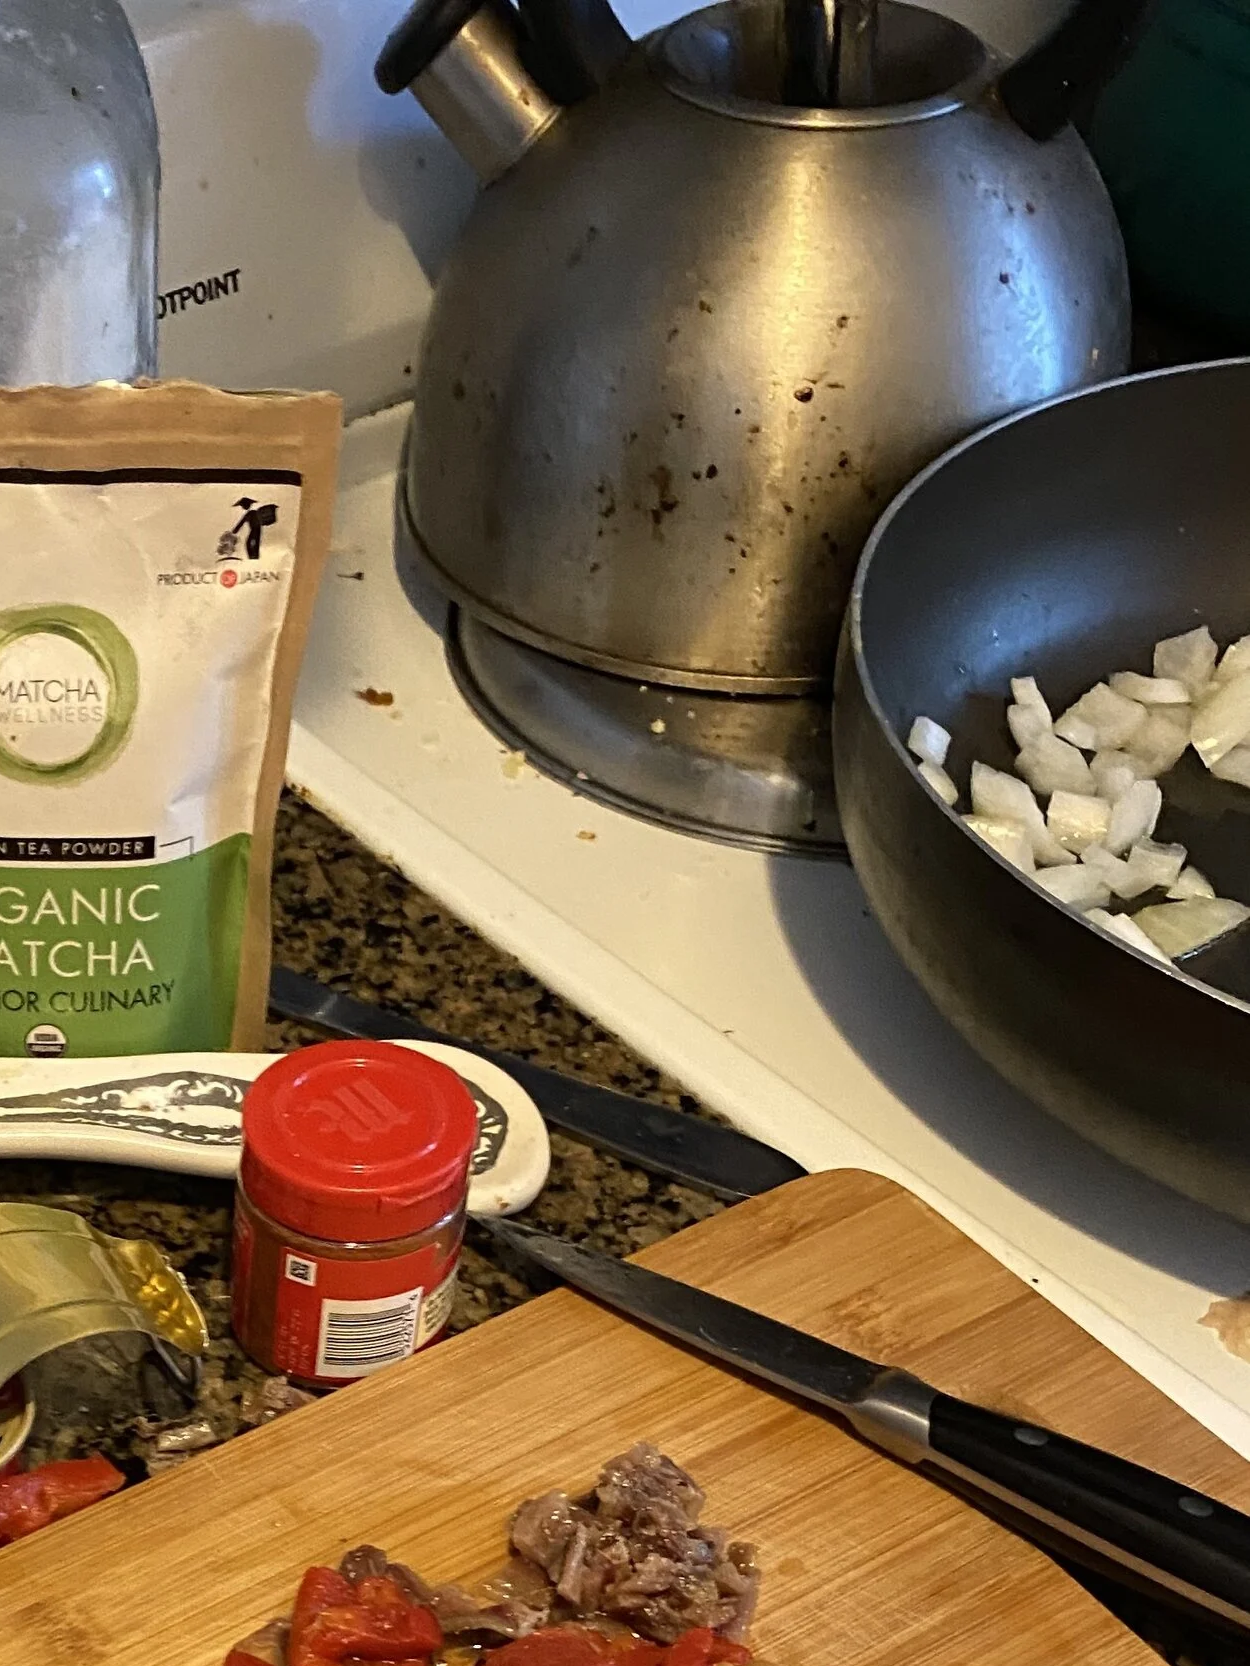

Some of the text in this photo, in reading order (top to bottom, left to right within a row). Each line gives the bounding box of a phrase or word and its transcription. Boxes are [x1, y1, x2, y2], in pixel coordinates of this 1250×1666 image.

[156, 571, 218, 586] PRODUCT
[239, 570, 280, 585] JAPAN
[16, 842, 51, 856] TEA
[60, 841, 145, 856] POWDER
[49, 979, 175, 1013] CULINARY
